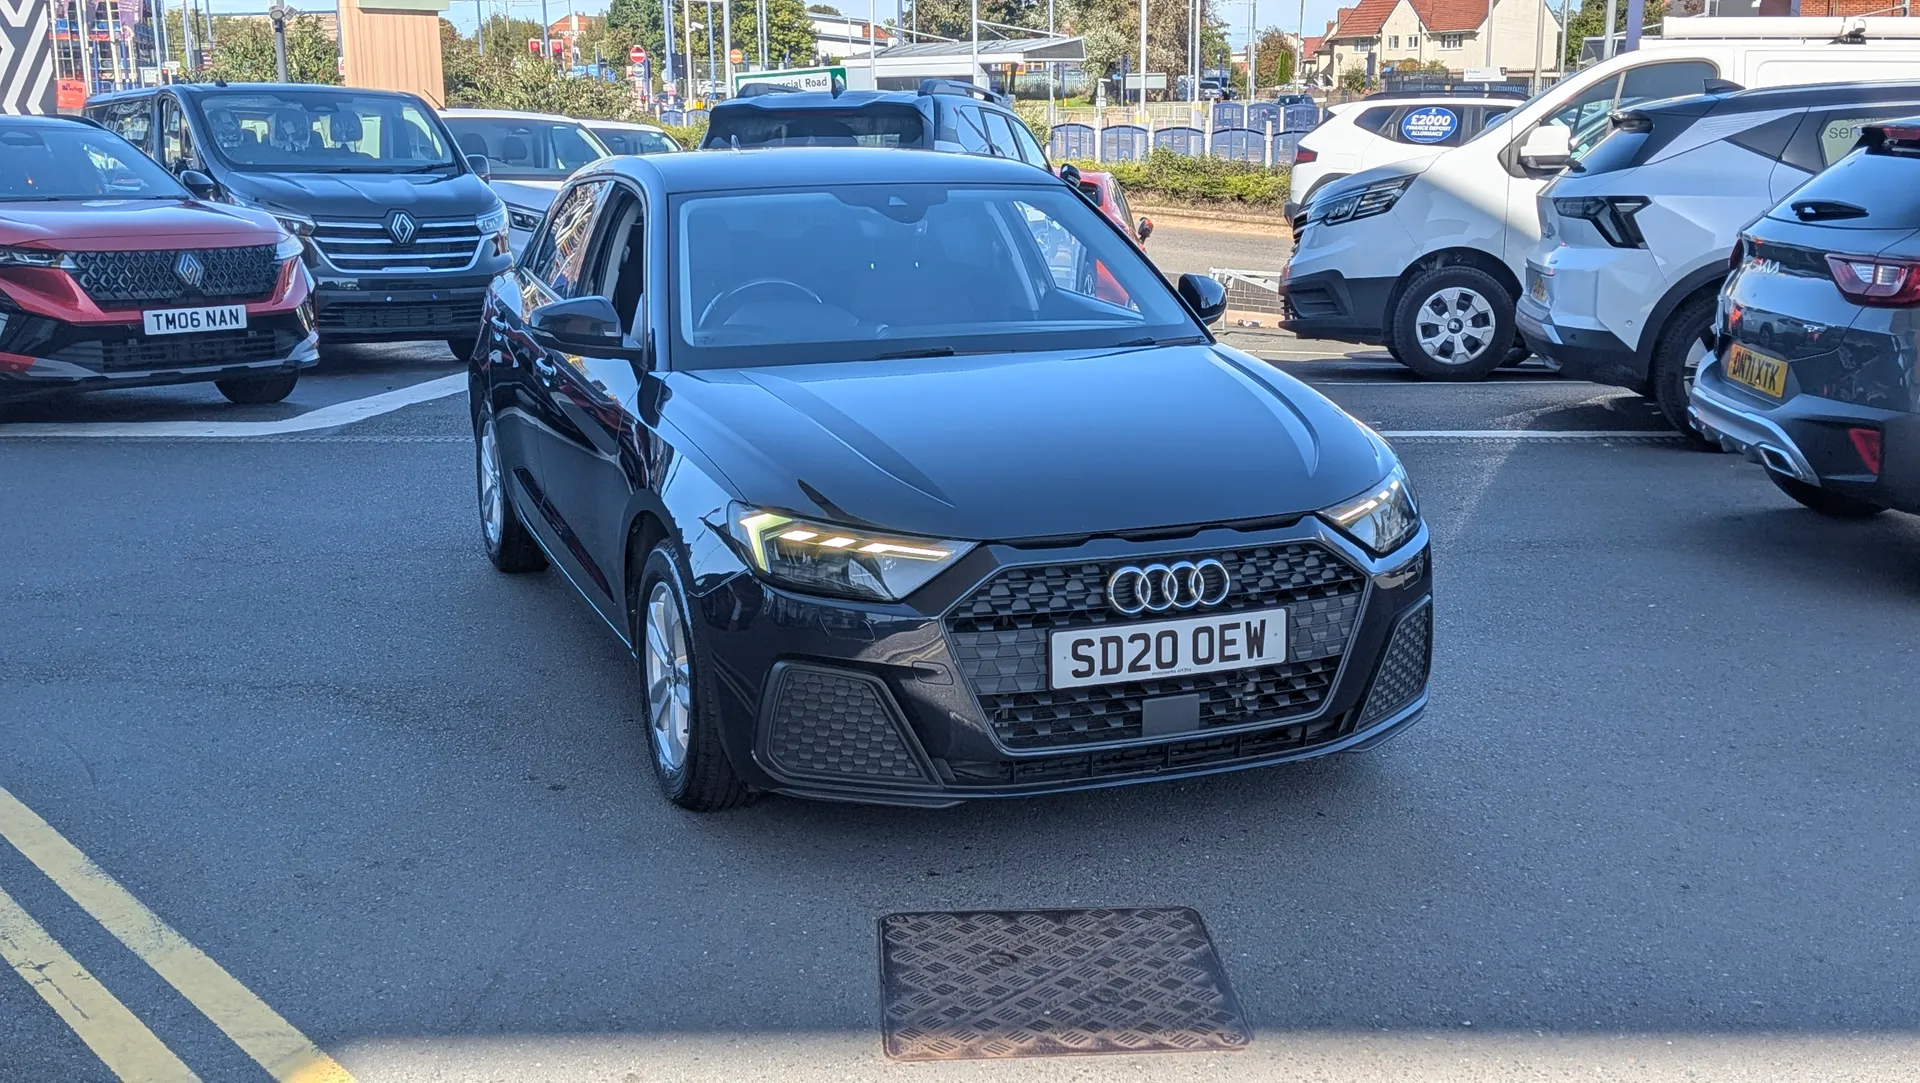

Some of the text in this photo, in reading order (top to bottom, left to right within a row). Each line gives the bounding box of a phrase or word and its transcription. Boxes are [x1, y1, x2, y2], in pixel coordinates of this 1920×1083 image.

[805, 77, 827, 88] Road
[1410, 114, 1452, 126] £2000
[152, 308, 240, 331] TM06 NAN
[1071, 619, 1267, 679] SD20 OEW
